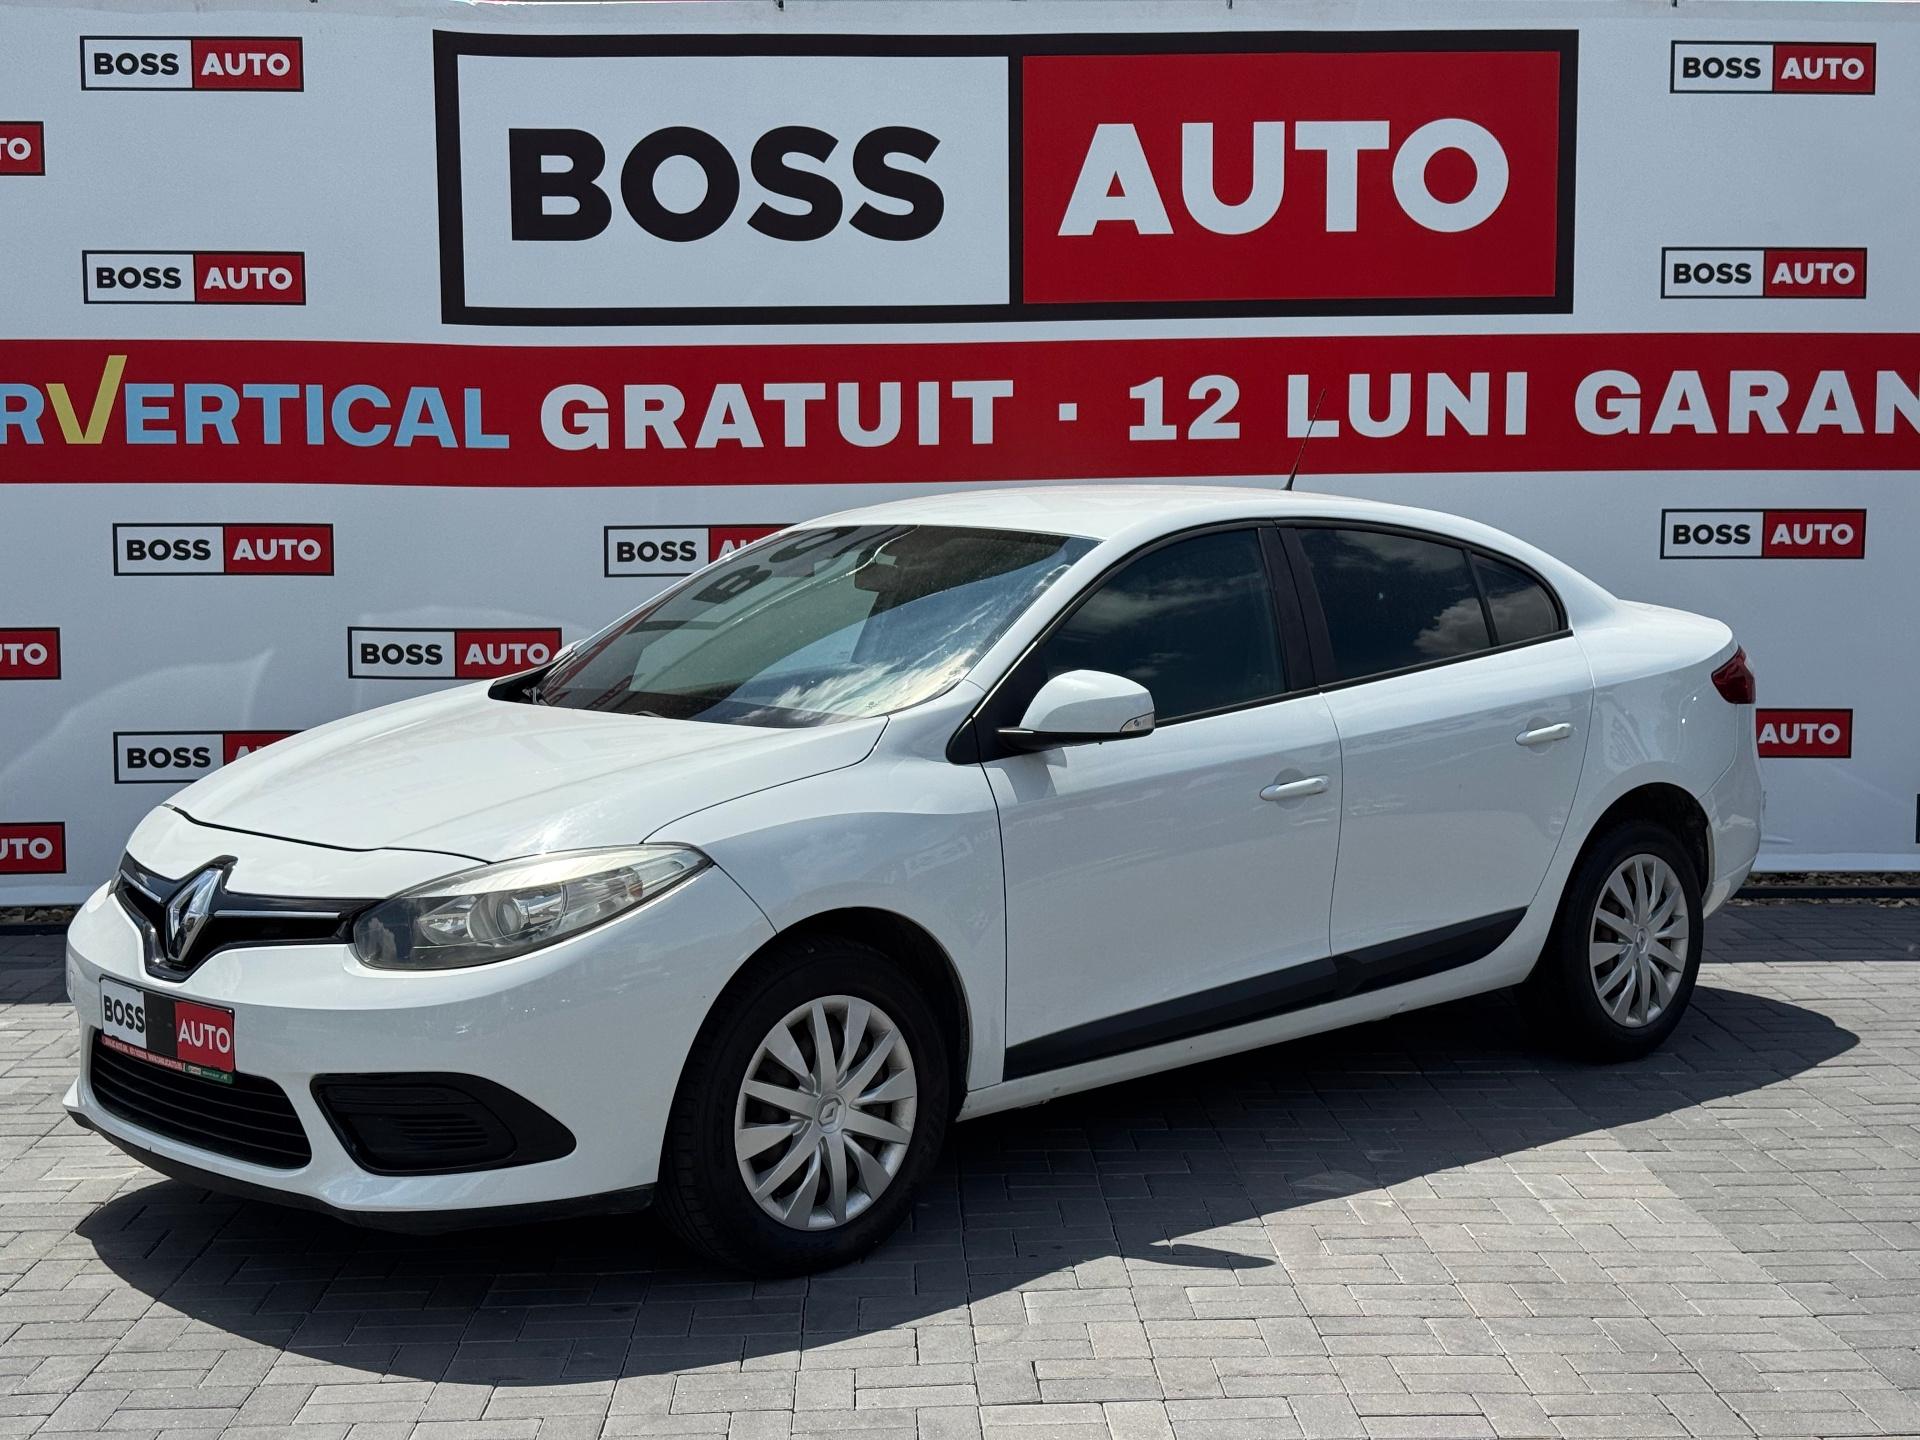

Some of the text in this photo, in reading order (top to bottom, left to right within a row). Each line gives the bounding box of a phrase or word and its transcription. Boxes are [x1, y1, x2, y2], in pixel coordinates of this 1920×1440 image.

[94, 53, 291, 76] BOSS AUTO
[1682, 58, 1865, 80] BOSS AUTO
[509, 118, 1509, 242] BOSS AUTO
[97, 267, 292, 290] BOSS AUTO
[1673, 263, 1855, 284] BOSS AUTO
[541, 380, 1013, 450] GRATUIT
[1130, 375, 1241, 440] 12
[1288, 372, 1528, 438] LUNI
[1575, 370, 1920, 435] GARAN
[1673, 524, 1853, 545] BOSS AUTO
[127, 539, 321, 560] BOSS AUTO
[617, 541, 697, 562] BOSS
[0, 643, 47, 665] TO
[361, 643, 549, 665] BOSS AUTO
[1759, 724, 1840, 744] AUTO
[127, 747, 212, 768] BOSS
[104, 995, 145, 1034] BOSS
[178, 1018, 231, 1054] AUTO
